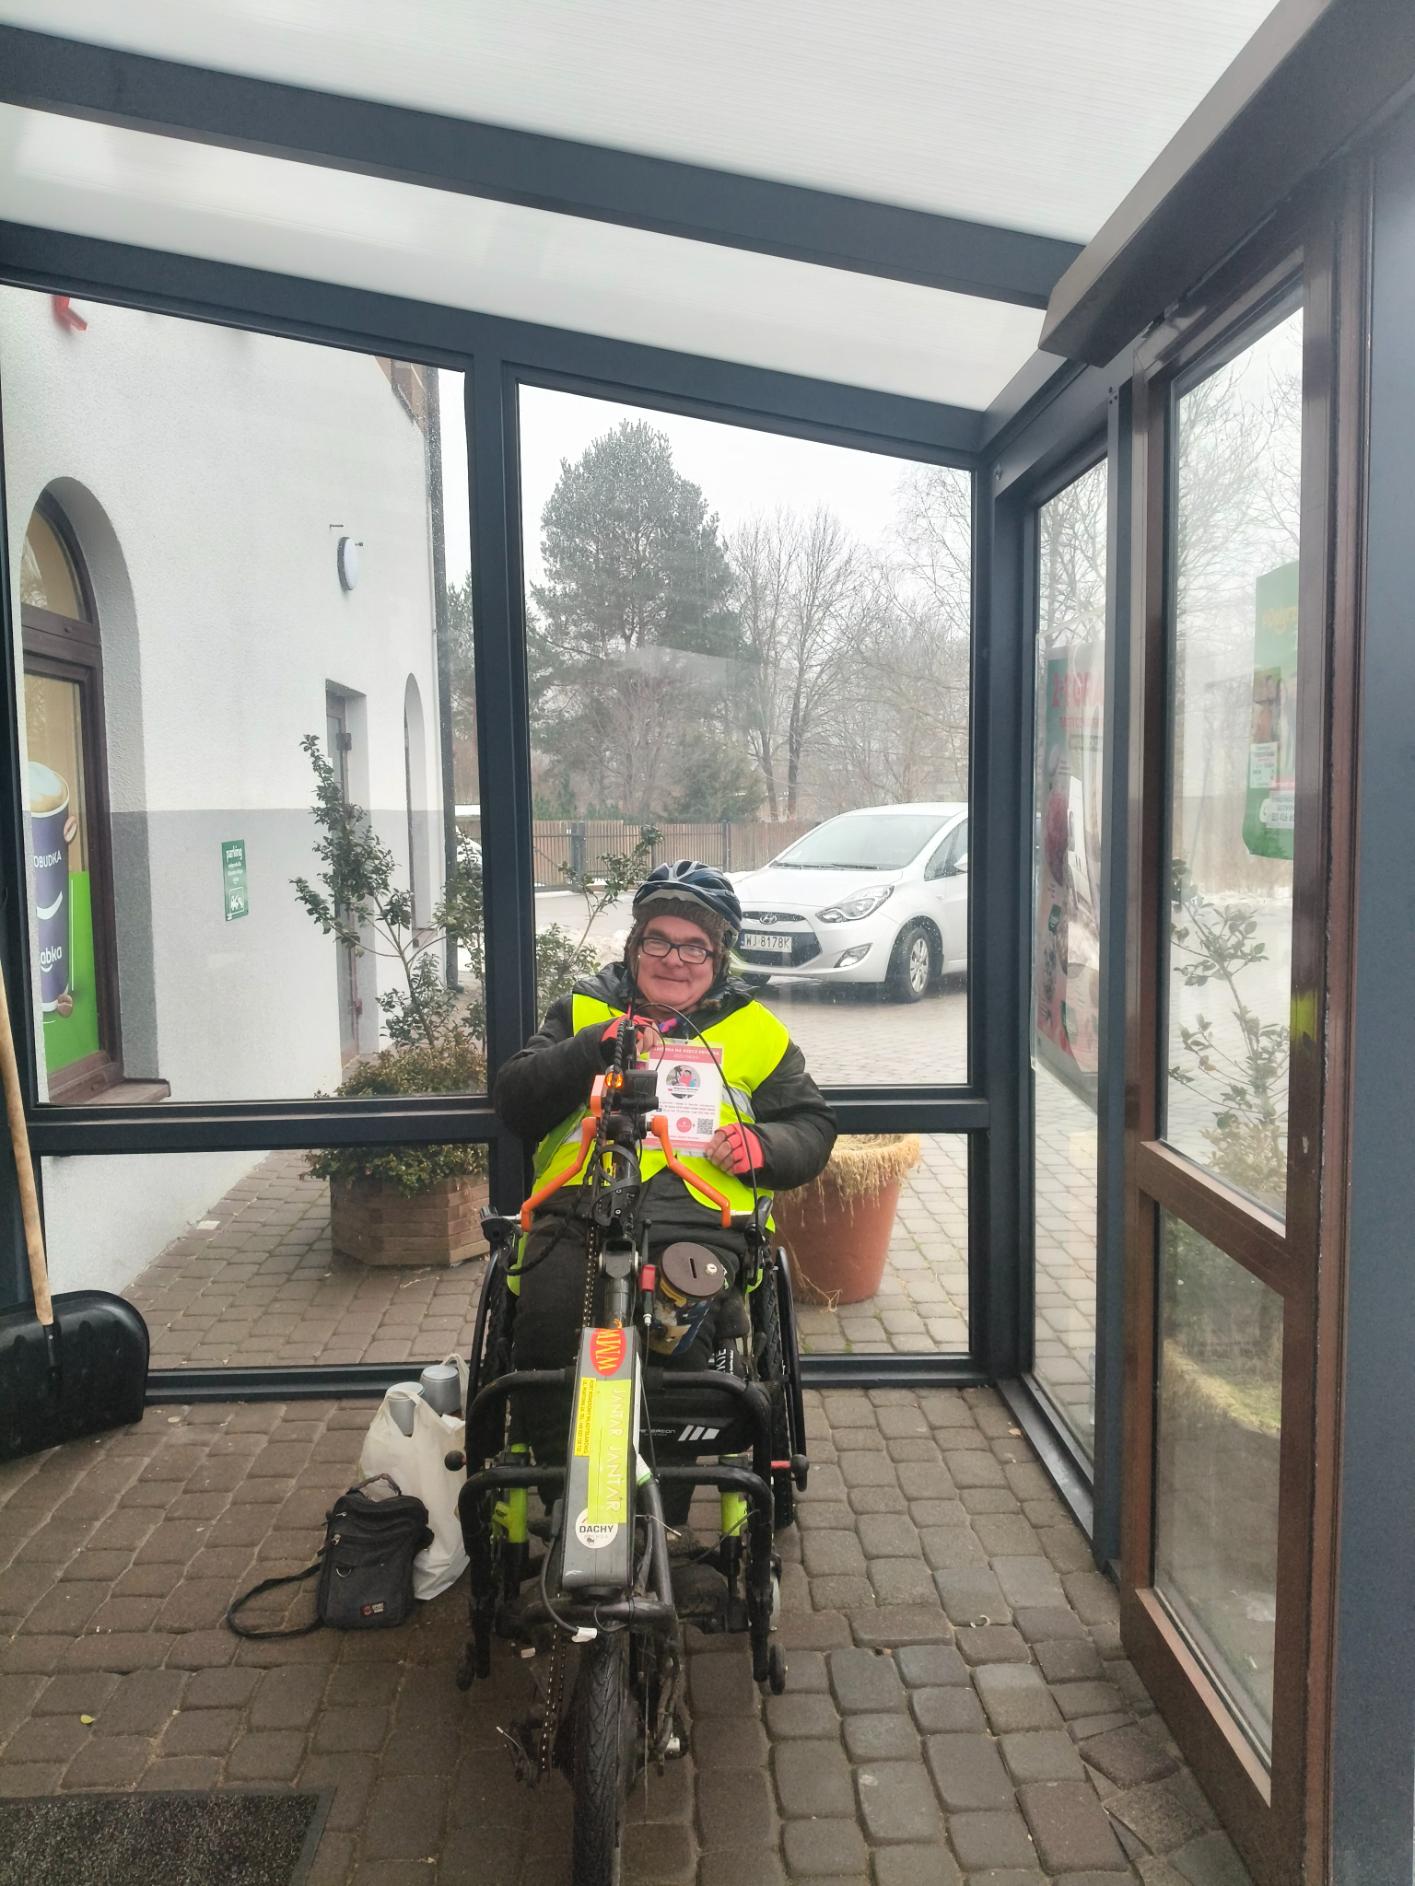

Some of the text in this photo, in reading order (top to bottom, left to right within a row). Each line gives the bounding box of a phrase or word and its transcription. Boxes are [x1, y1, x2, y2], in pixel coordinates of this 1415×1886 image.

[33, 850, 62, 868] OBUDKA
[40, 945, 63, 966] abka
[606, 1388, 626, 1512] JANTAR JANTAR
[578, 1525, 614, 1534] DACHY
